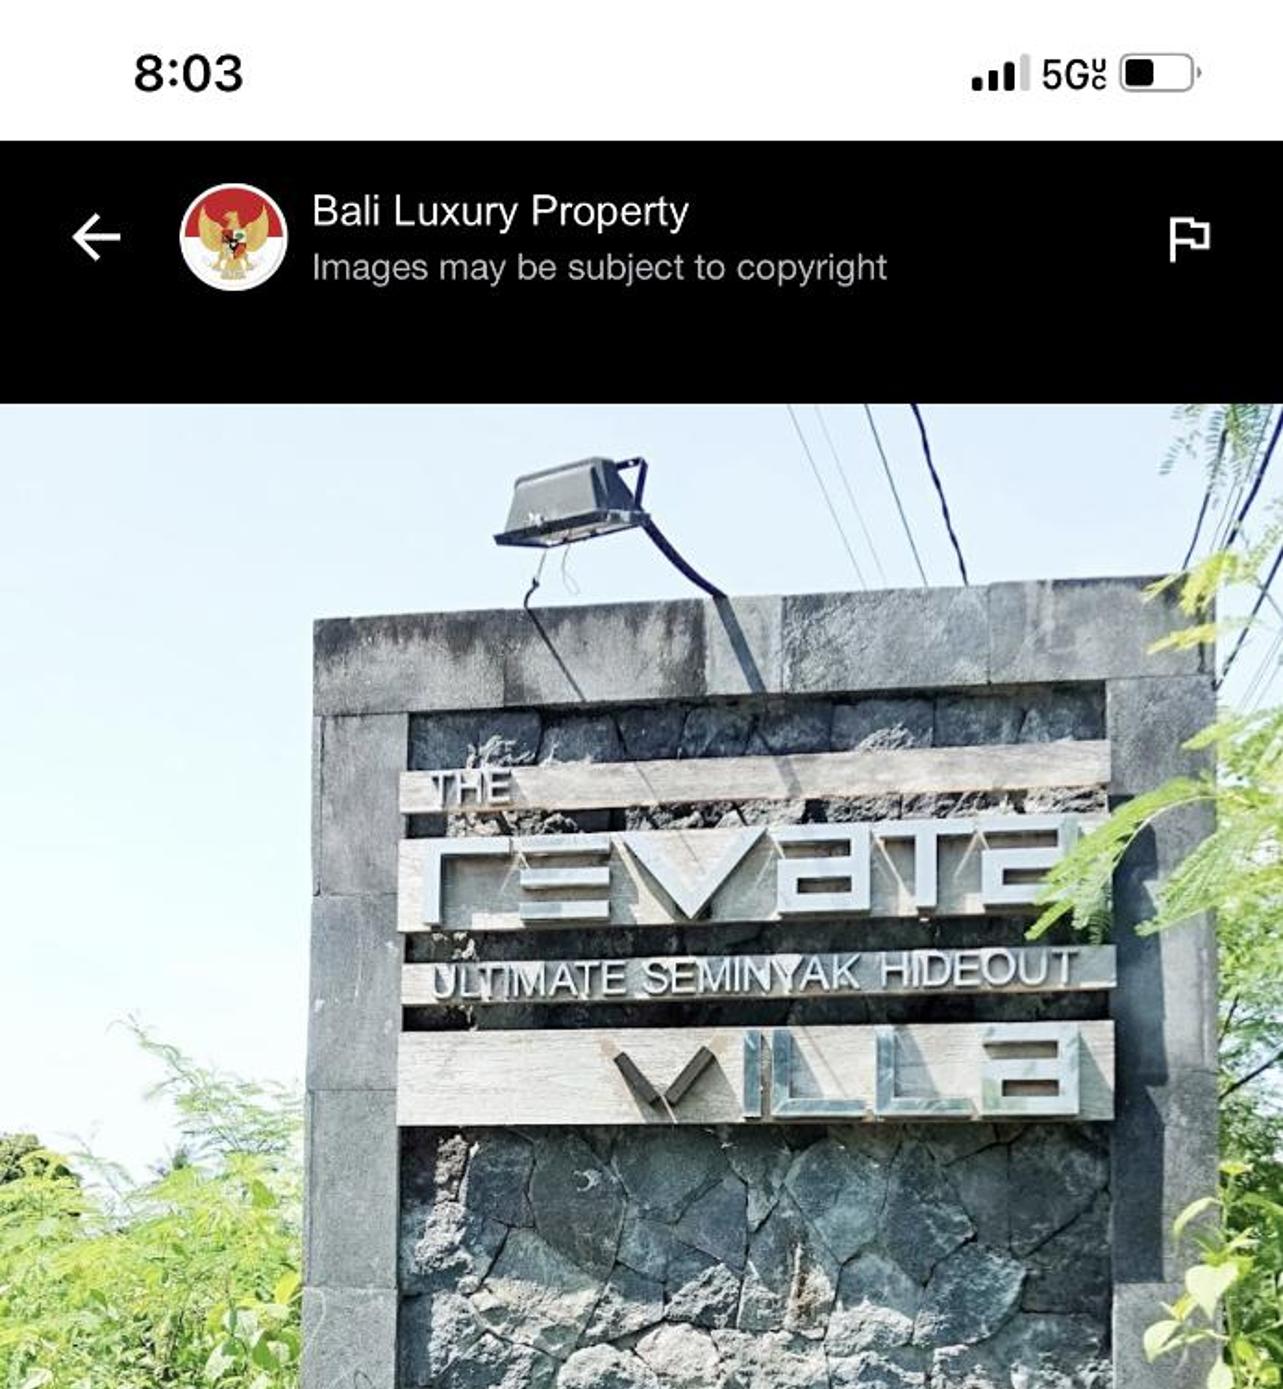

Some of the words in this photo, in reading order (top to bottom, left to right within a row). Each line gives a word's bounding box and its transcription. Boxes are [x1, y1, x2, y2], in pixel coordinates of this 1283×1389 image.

[134, 53, 243, 93] 8:03
[313, 194, 379, 227] Bali
[395, 194, 519, 235] Luxury
[532, 194, 690, 235] Property
[313, 253, 429, 288] Images
[440, 258, 507, 288] may
[517, 252, 557, 281] be
[569, 252, 685, 288] subject
[693, 254, 726, 281] to
[737, 252, 888, 288] copyright
[432, 770, 512, 808] THE
[432, 959, 627, 999] ULTIMATE
[641, 952, 861, 994] SEMINYAK
[879, 947, 1078, 987] HIDEOUT
